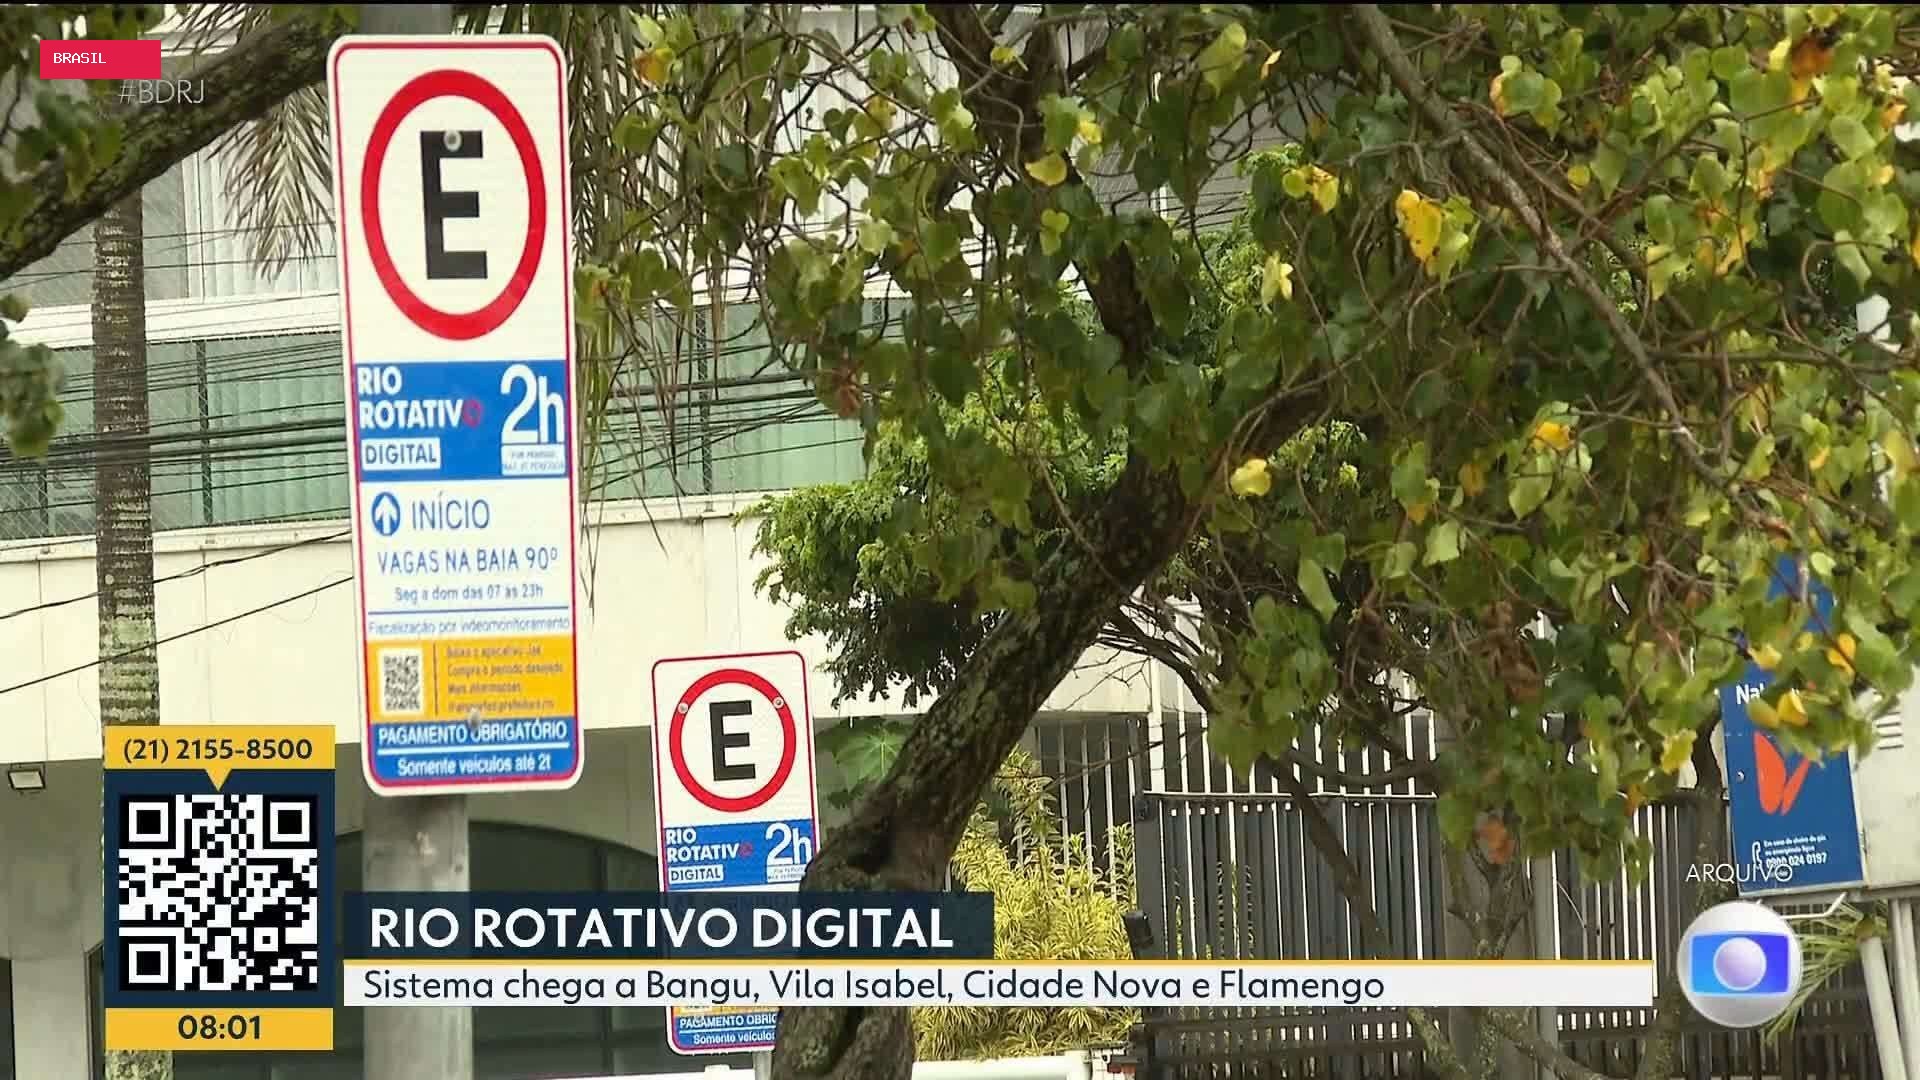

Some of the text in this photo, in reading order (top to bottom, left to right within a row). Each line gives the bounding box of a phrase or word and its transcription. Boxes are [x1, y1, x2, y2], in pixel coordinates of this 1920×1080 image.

[420, 131, 488, 280] E
[357, 366, 402, 395] RIO
[500, 364, 565, 444] 2h
[365, 443, 437, 465] DIGITAL
[412, 491, 490, 530] INÍCIO
[378, 550, 439, 575] VAGAS
[446, 549, 471, 573] NA
[477, 548, 519, 572] BAIA
[395, 586, 418, 605] Seg
[432, 585, 459, 600] dom
[463, 584, 483, 600] das
[487, 583, 500, 599] 07
[522, 582, 543, 597] 23h
[379, 718, 567, 746] PAGAMENTO OBRIGATÓRIO
[709, 700, 756, 781] E
[397, 752, 551, 776] Somente veículos até 2t
[666, 828, 697, 845] RIO
[765, 823, 812, 865] 2h
[1788, 854, 1805, 867] 024
[1806, 851, 1828, 865] 0197
[670, 867, 722, 882] DIGITAL
[679, 1016, 745, 1029] PAGAMENTO
[693, 1033, 736, 1046] Somente
